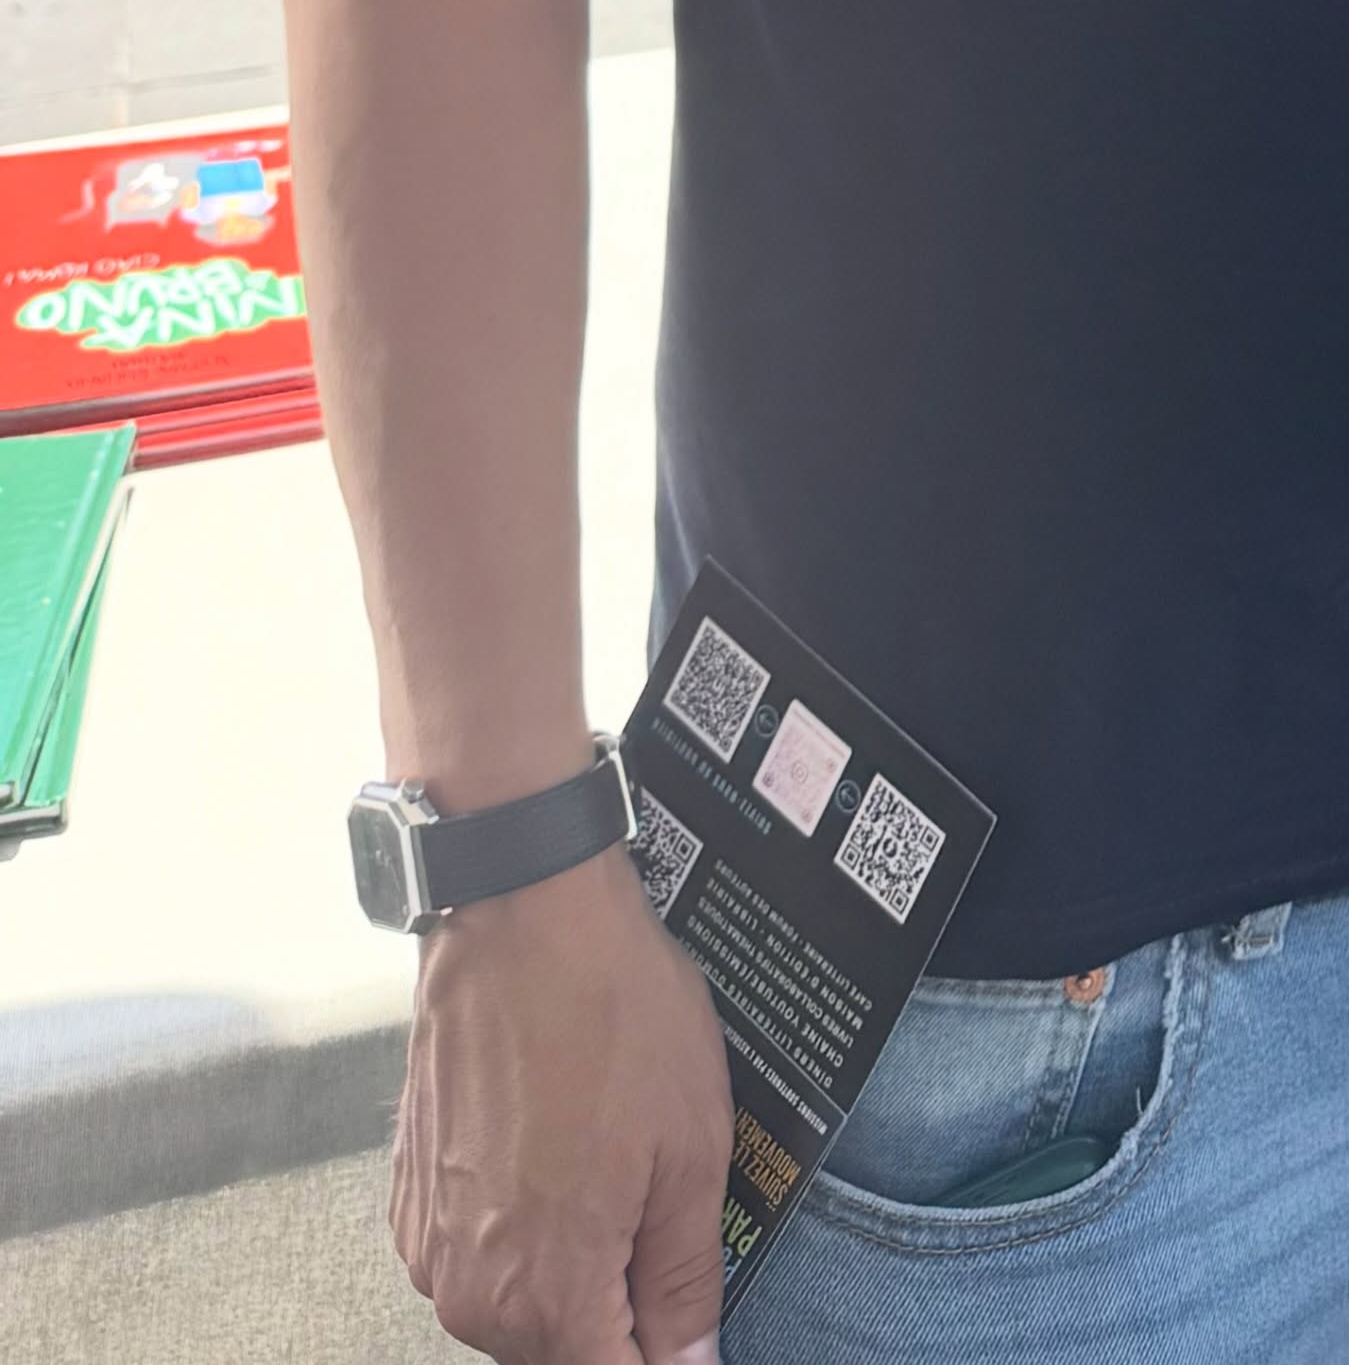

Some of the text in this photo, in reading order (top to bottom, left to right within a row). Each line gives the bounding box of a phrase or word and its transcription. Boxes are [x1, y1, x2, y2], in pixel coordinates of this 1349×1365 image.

[26, 262, 242, 331] BRUNO
[88, 276, 298, 349] NINA
[706, 877, 758, 931] LIBRAIRIE
[820, 985, 863, 1030] MAISON
[744, 1156, 789, 1206] SUIVEZ
